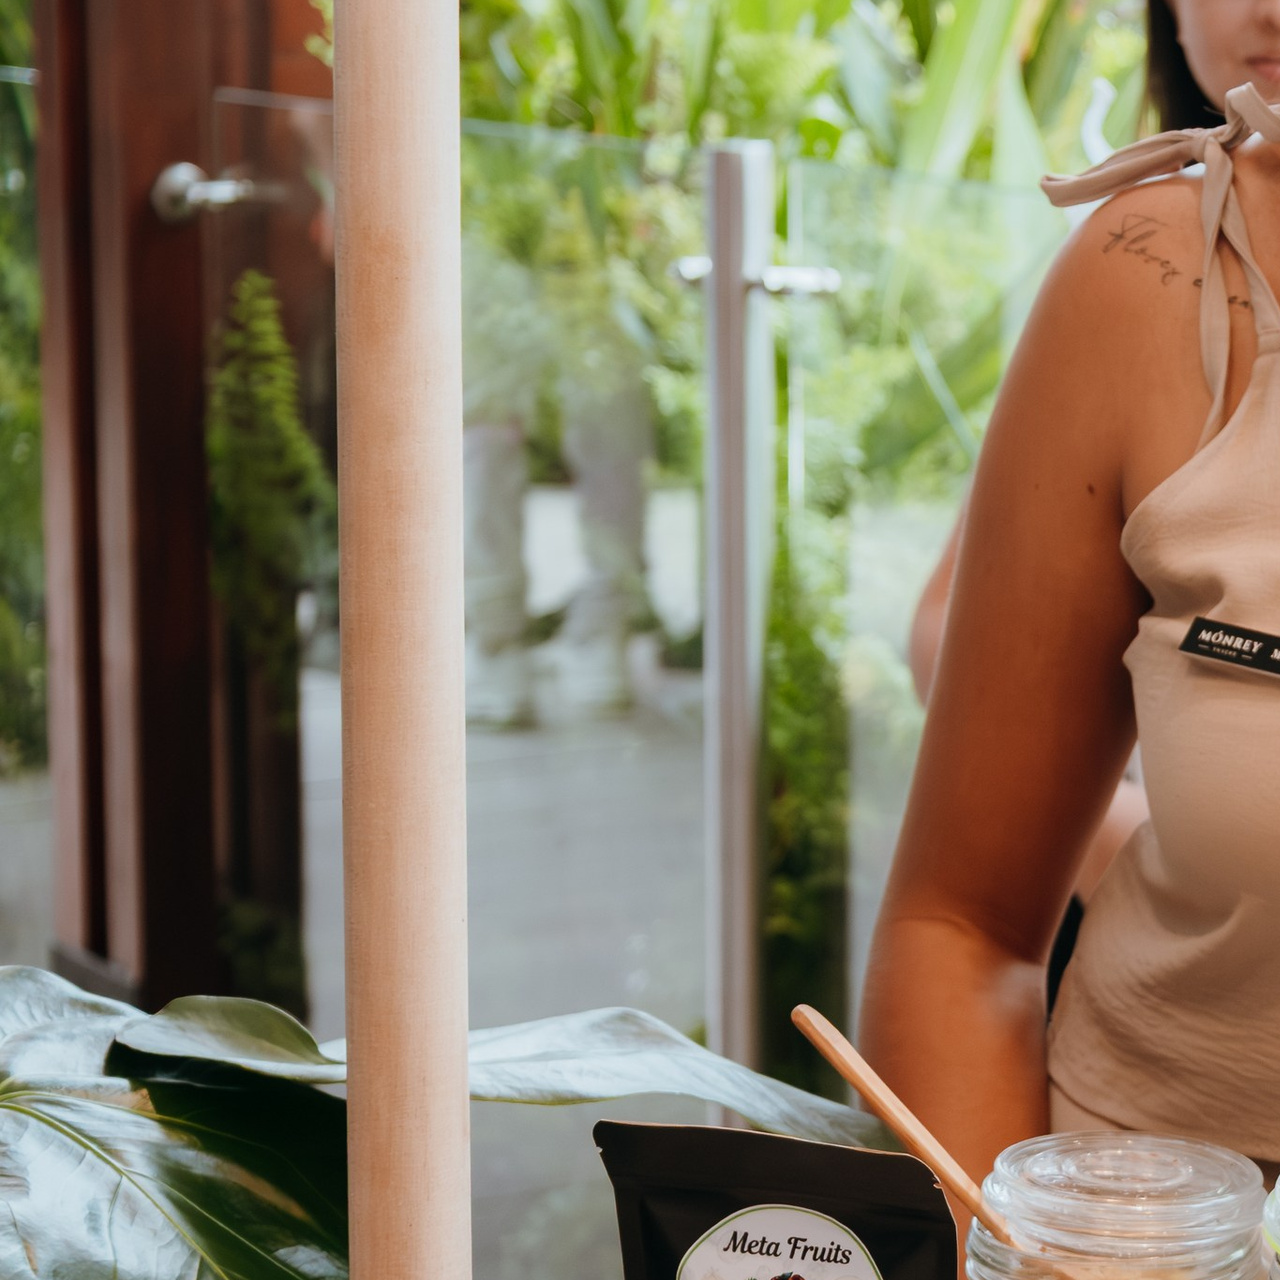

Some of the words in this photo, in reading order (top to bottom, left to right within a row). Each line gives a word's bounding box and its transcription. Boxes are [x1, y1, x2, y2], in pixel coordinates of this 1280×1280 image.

[1198, 629, 1263, 653] MÓNREY
[723, 1230, 782, 1257] Meta
[787, 1236, 852, 1265] Fruits
